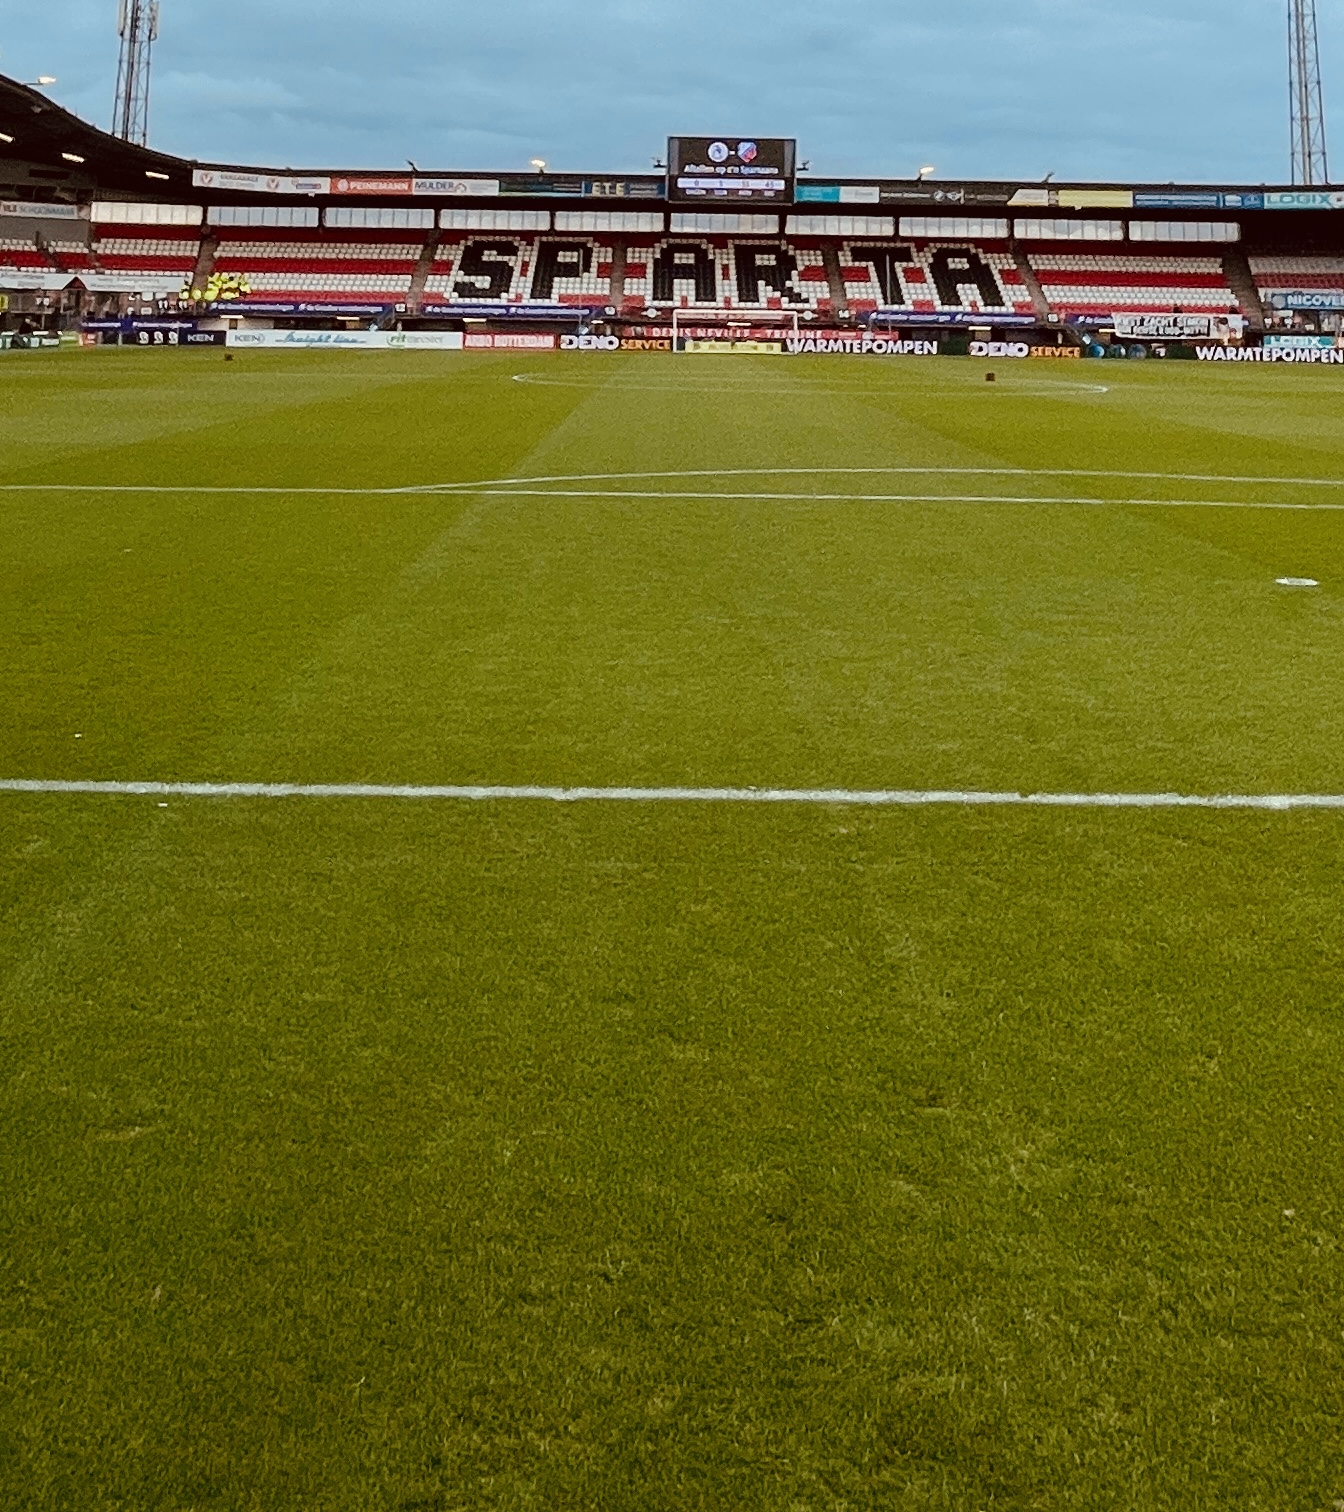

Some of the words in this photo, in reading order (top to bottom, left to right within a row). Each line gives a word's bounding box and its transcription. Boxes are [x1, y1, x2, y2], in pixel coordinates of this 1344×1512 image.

[414, 180, 455, 191] MULDER
[1267, 192, 1334, 208] LOGIX
[455, 240, 1005, 306] SPARTA
[187, 334, 215, 342] KEN
[652, 328, 692, 338] DENIS
[560, 335, 619, 350] DENO
[620, 339, 671, 350] SERVICE
[785, 338, 938, 355] WARMTEPOMPEN
[970, 341, 1029, 357] DENO
[1030, 346, 1081, 358] SERVICE
[1195, 344, 1344, 364] WARMTEPOMPEN
